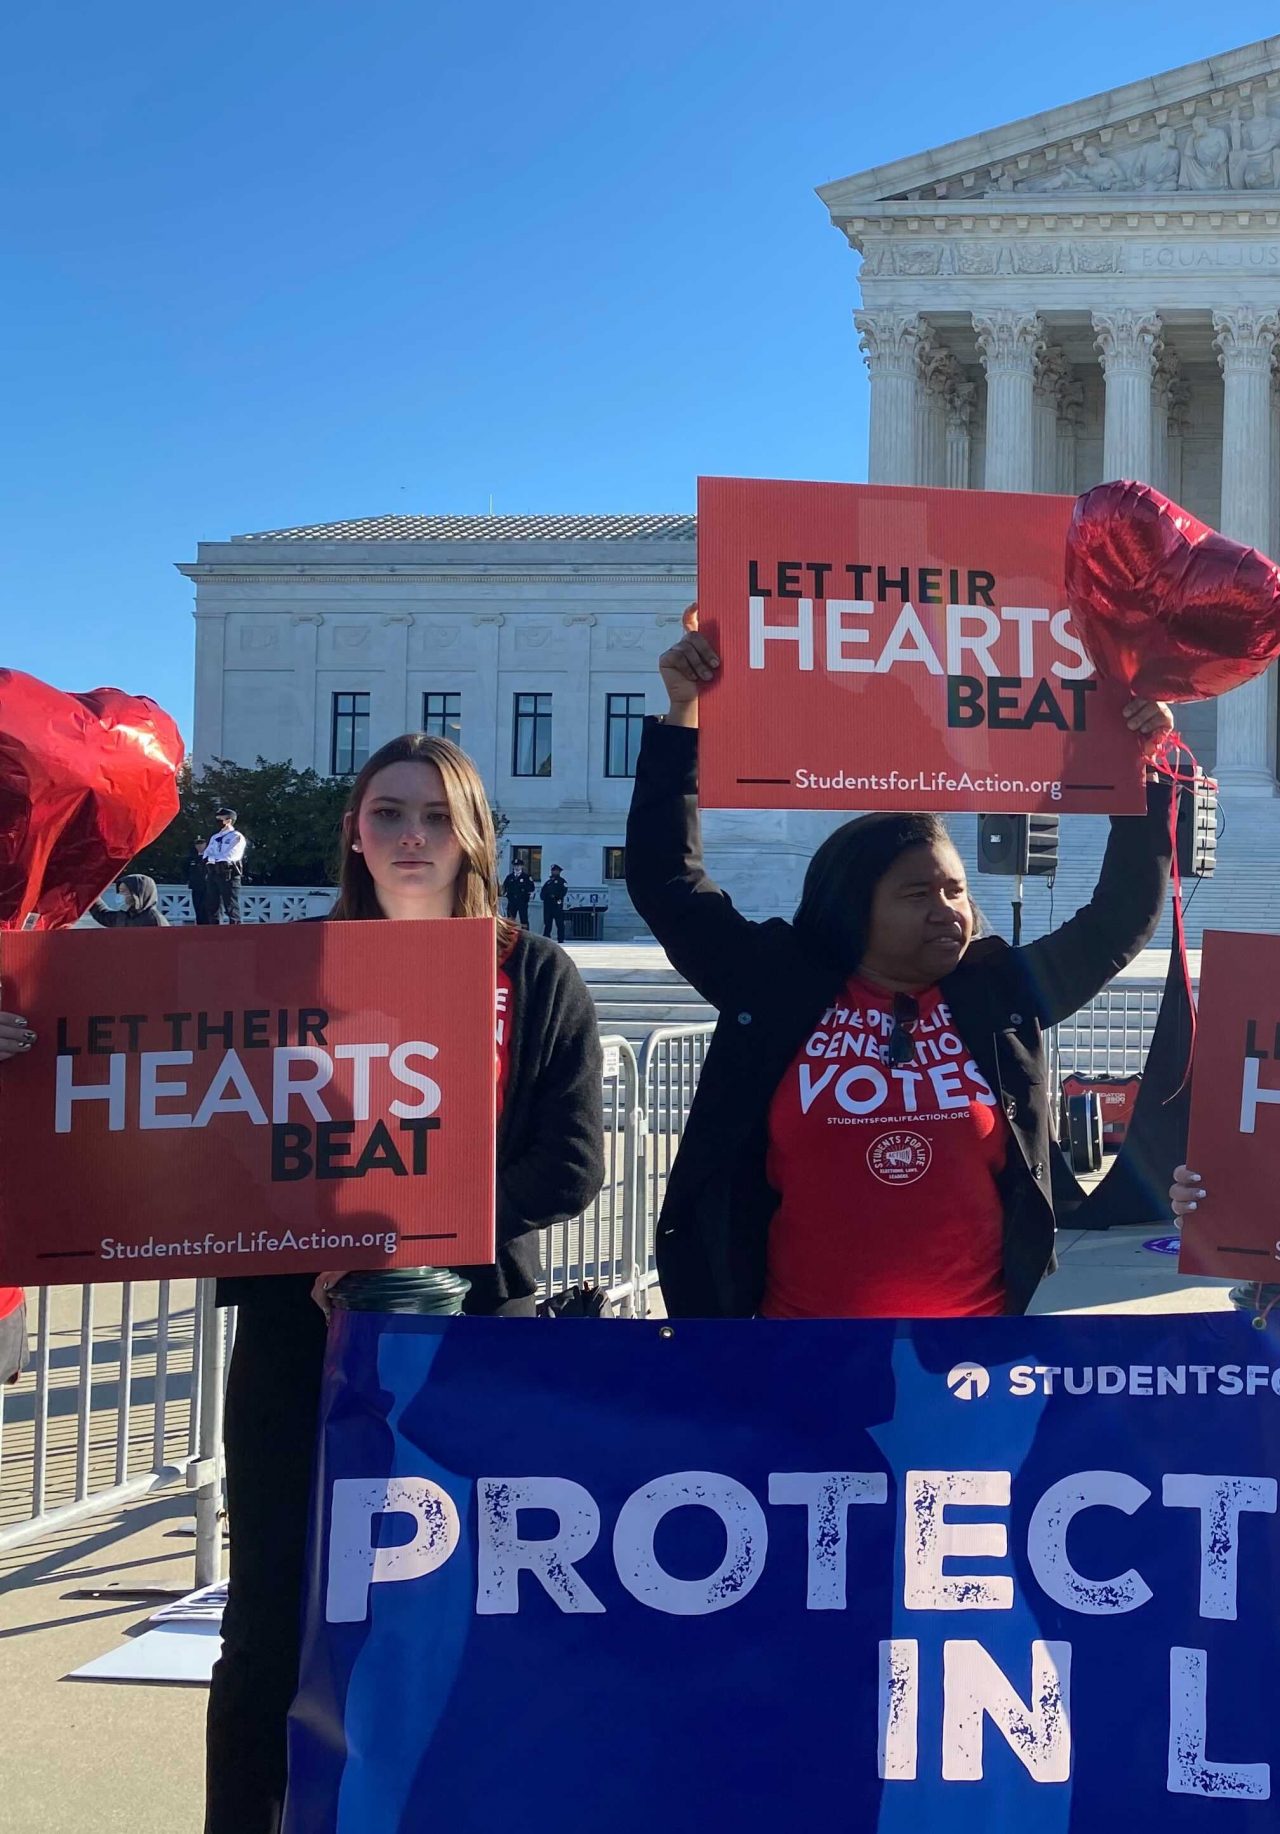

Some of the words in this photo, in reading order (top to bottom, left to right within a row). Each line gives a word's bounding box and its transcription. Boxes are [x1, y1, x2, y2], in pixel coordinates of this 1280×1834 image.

[1142, 247, 1225, 268] EQUAL
[749, 560, 833, 599] LET
[845, 564, 996, 607] THEIR
[748, 596, 1096, 681] HEARTS
[947, 674, 1098, 732] BEAT
[795, 768, 1062, 800] StudentsforLifeAction.org
[56, 1016, 148, 1055] LET
[164, 1008, 329, 1052] THEIR
[805, 1031, 963, 1068] GENERTIO
[54, 1040, 442, 1134] HEARTS
[799, 1060, 997, 1115] VOTES
[826, 1110, 970, 1125] STUDENTSFORLIFEACTION.ORG
[271, 1116, 441, 1182] BEAT
[872, 1135, 901, 1169] STUDENTS
[904, 1135, 922, 1149] FOR
[915, 1148, 926, 1167] LIFE
[100, 1228, 397, 1261] StudentsforLifeAction.org
[878, 1639, 1072, 1781] IN
